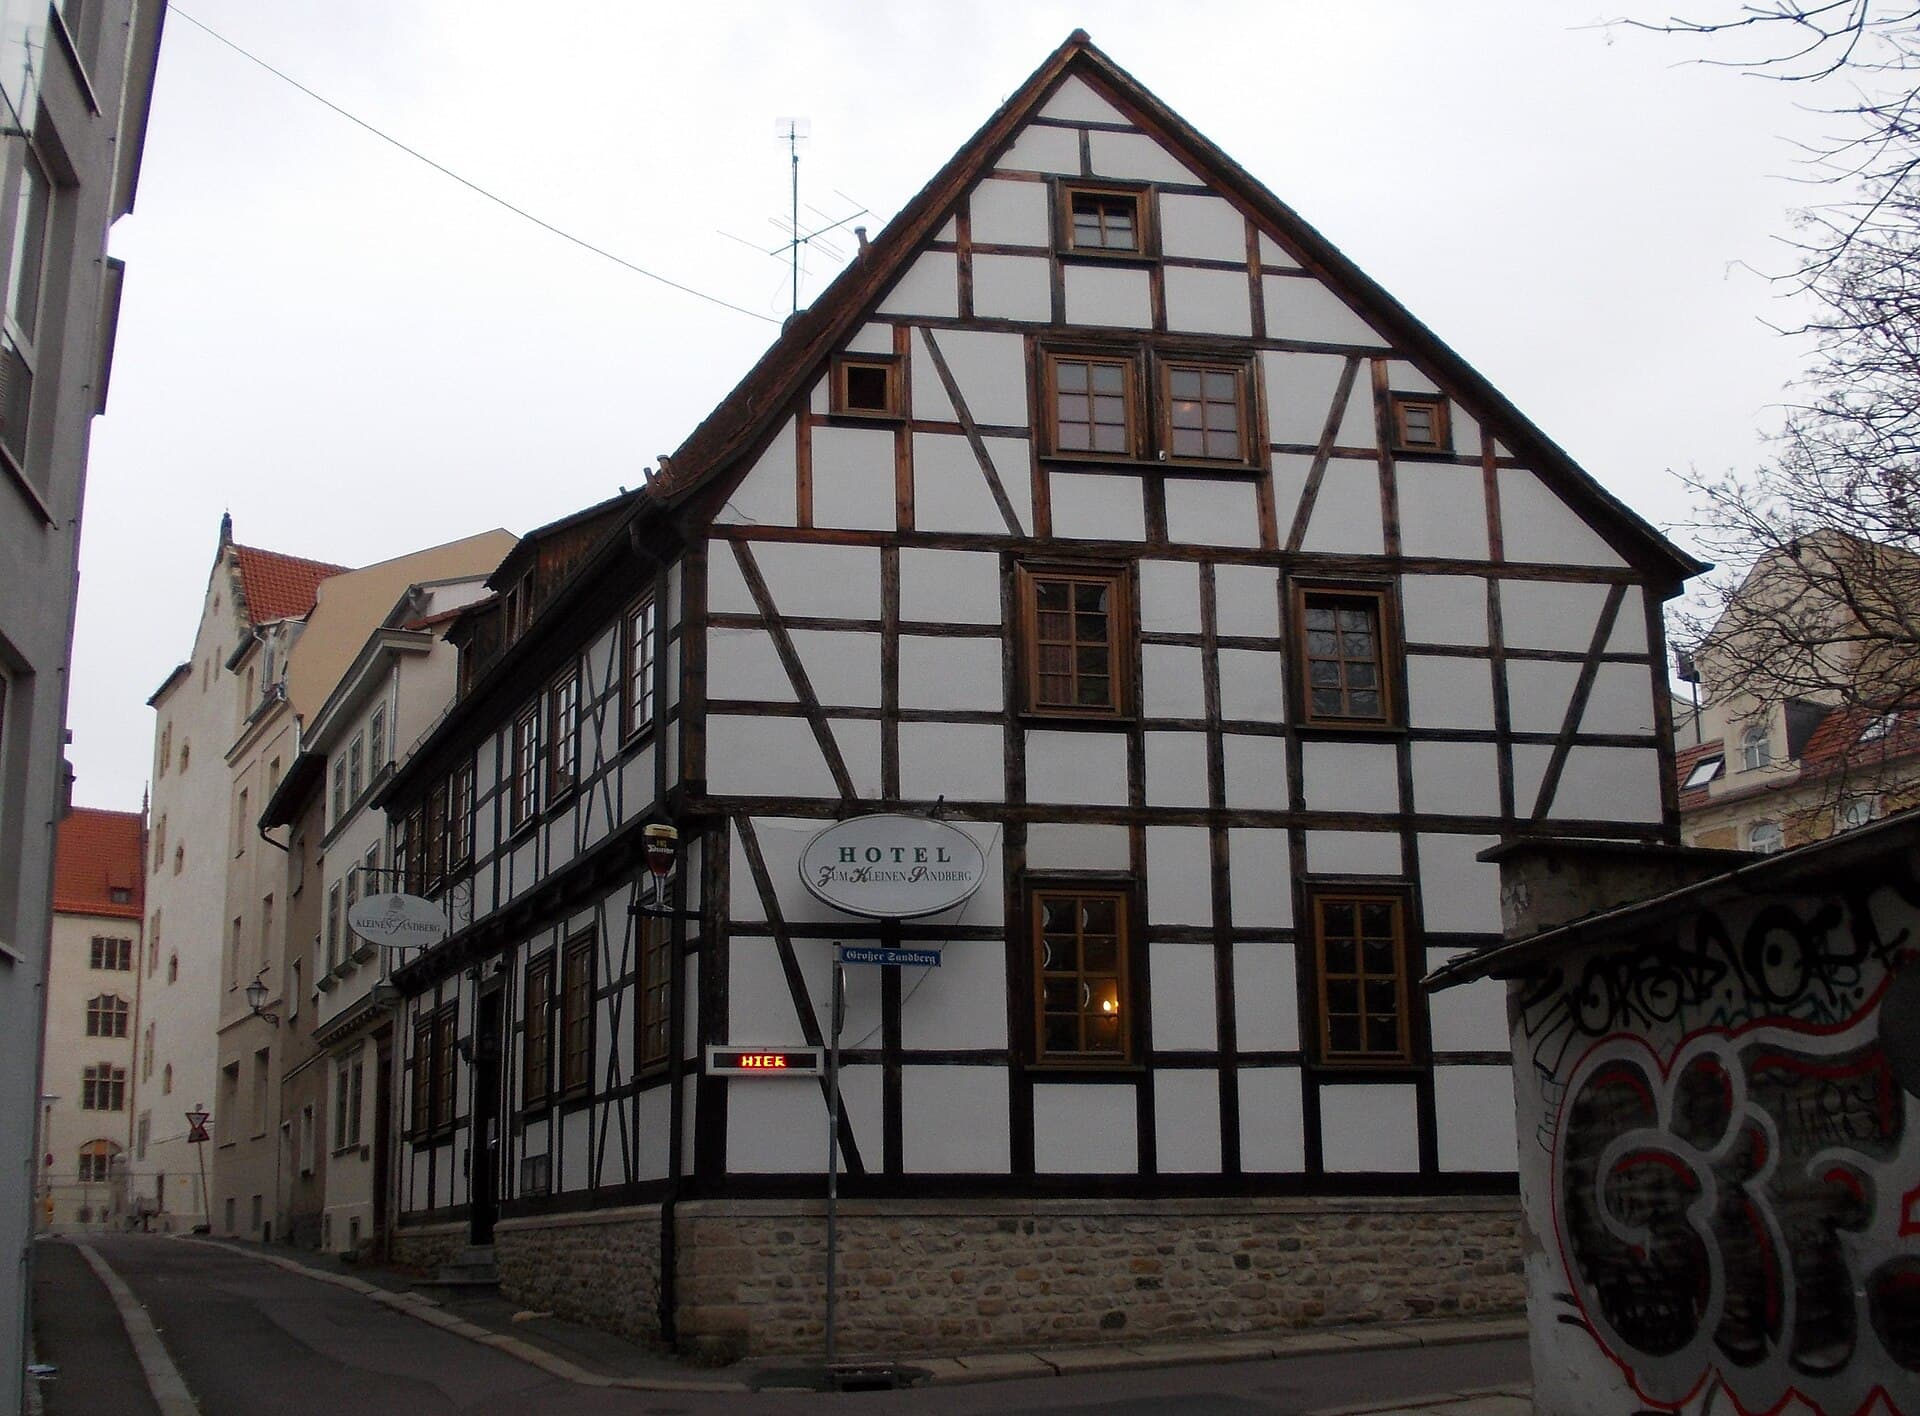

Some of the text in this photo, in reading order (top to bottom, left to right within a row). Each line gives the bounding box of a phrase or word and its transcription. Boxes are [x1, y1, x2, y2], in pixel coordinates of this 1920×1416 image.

[839, 847, 951, 863] HOTEL
[818, 865, 972, 887] ZUM KLEINEN SANDBERG
[846, 950, 936, 965] Großer Sandberg
[741, 1055, 787, 1067] HIER
